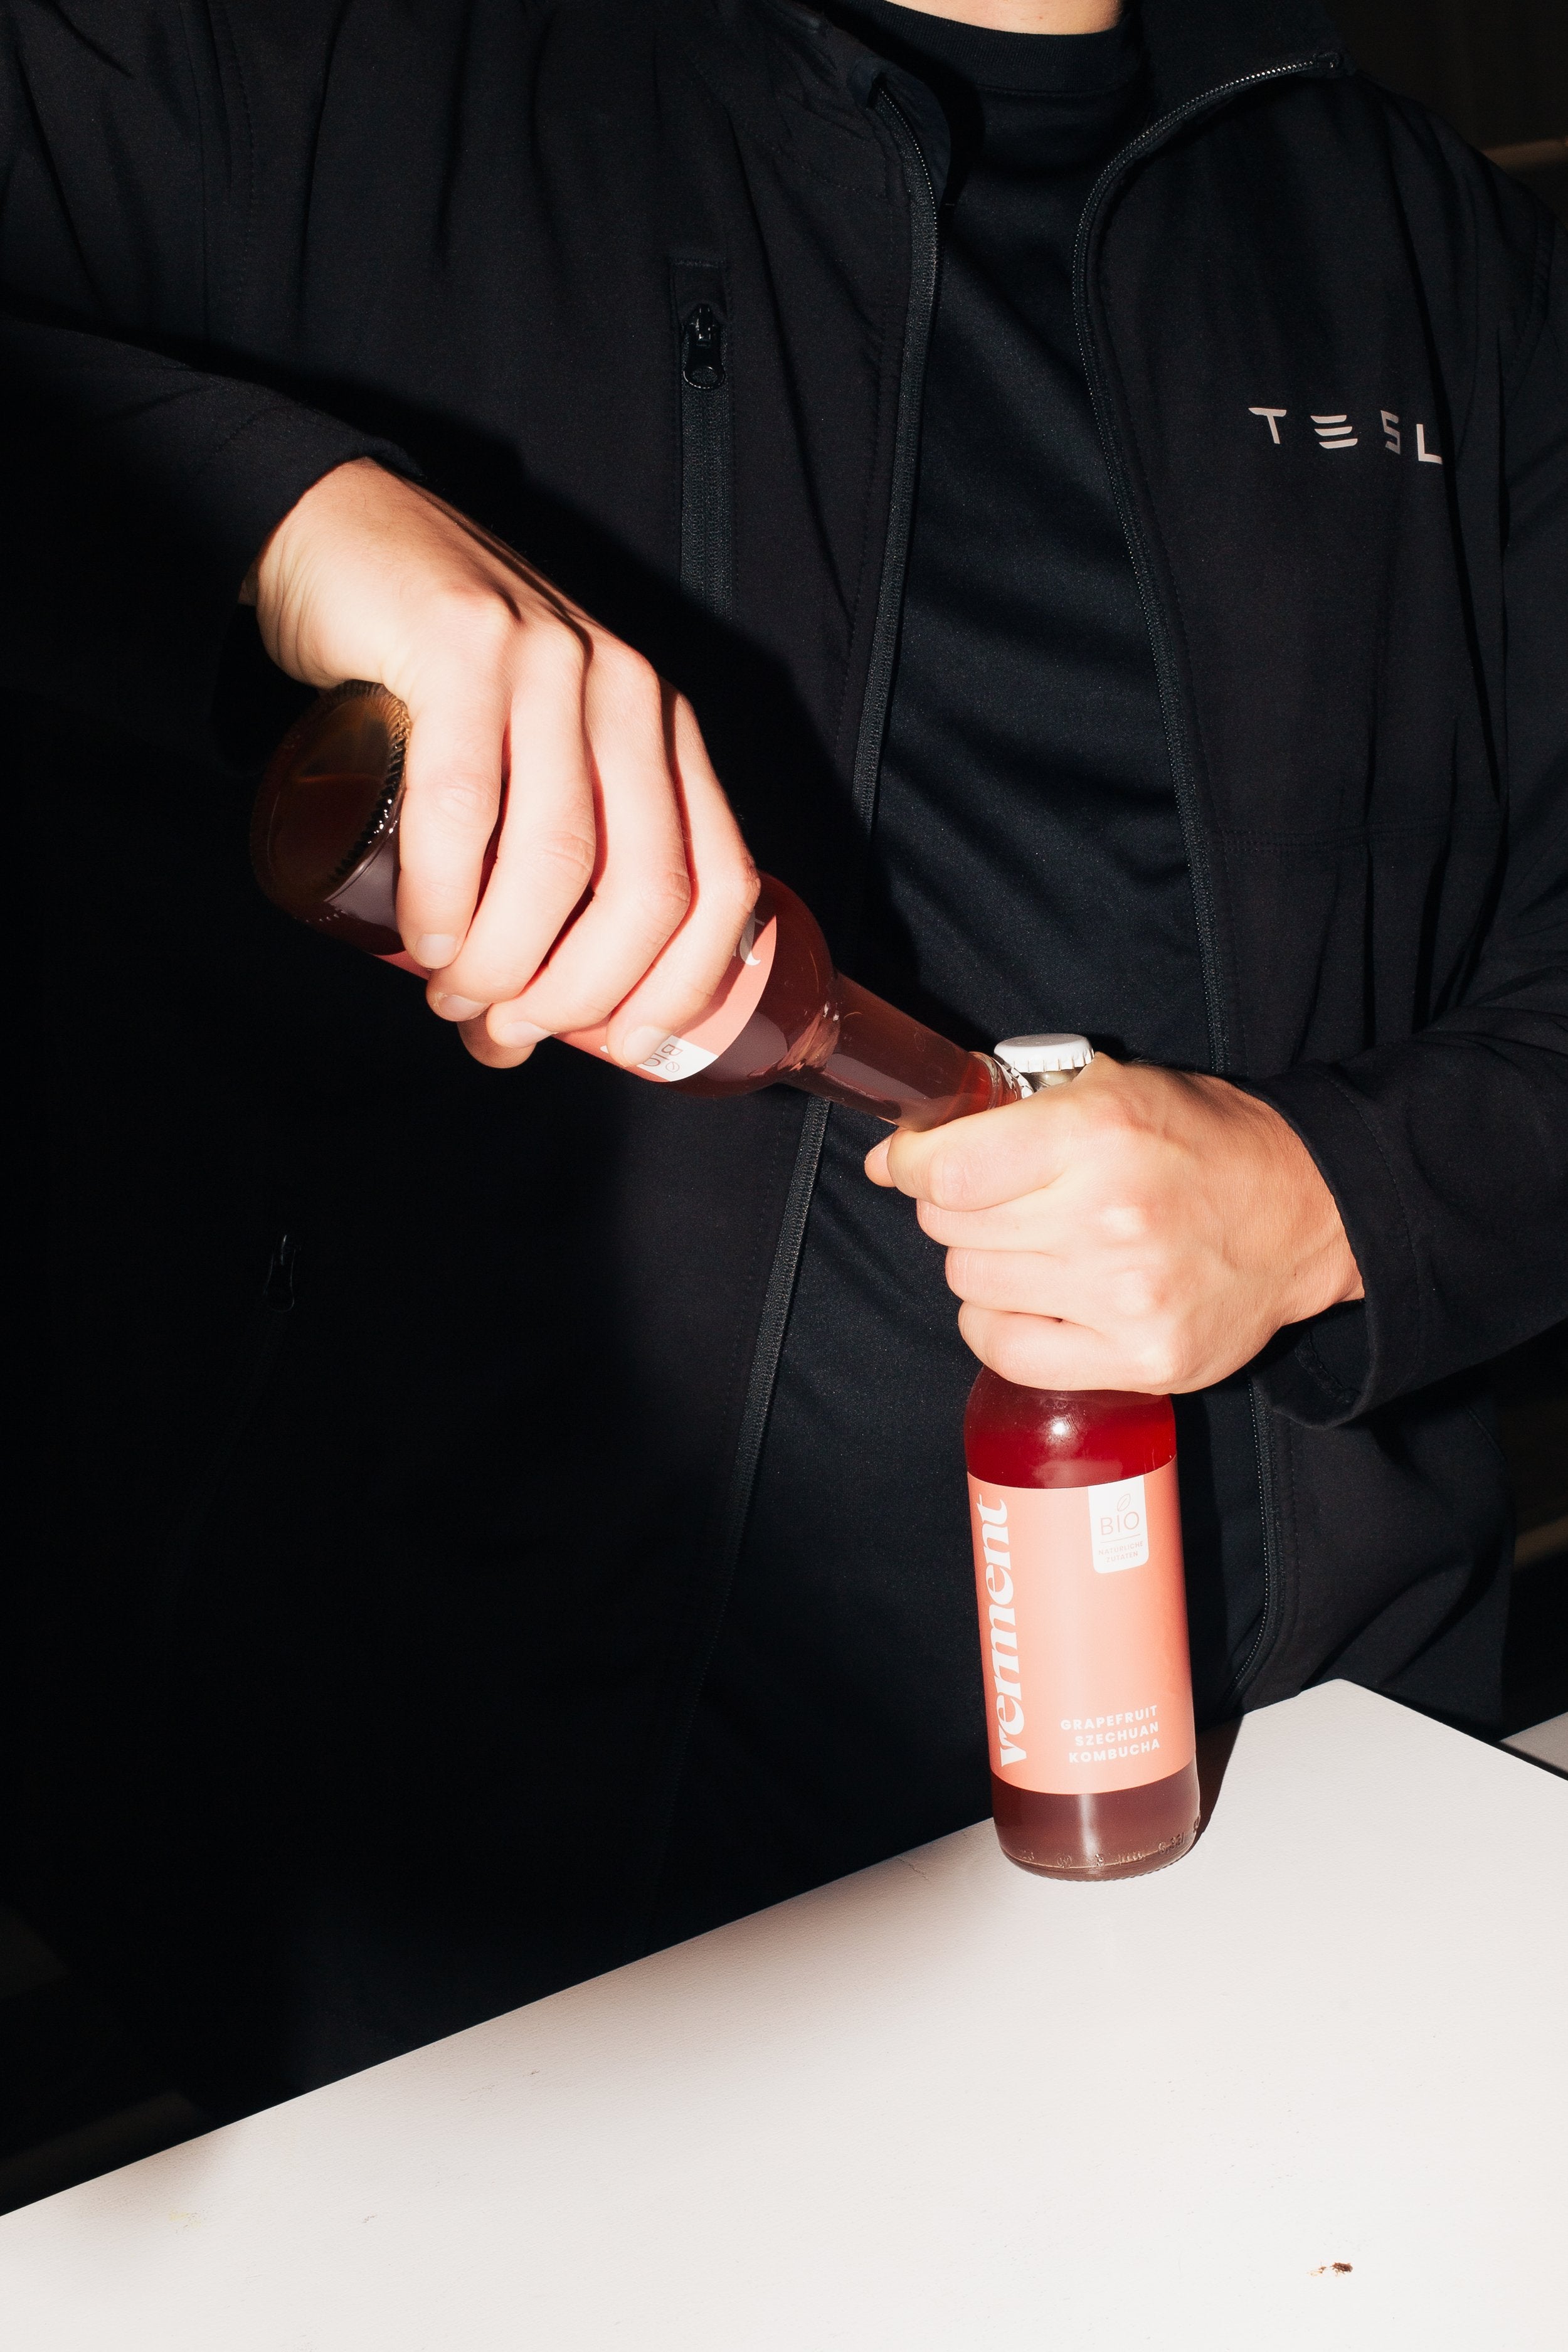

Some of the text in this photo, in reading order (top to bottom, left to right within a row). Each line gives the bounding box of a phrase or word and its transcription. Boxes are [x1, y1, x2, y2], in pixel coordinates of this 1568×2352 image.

[1248, 408, 1443, 464] TESL
[1101, 1512, 1139, 1535] BIO
[1106, 1551, 1138, 1562] ZUTATEN
[977, 1494, 1027, 1767] verment
[1061, 1705, 1157, 1730] GRAPEFRUIT
[1075, 1722, 1158, 1746] SZECHUAN
[1069, 1739, 1160, 1762] KOMBUCHA
